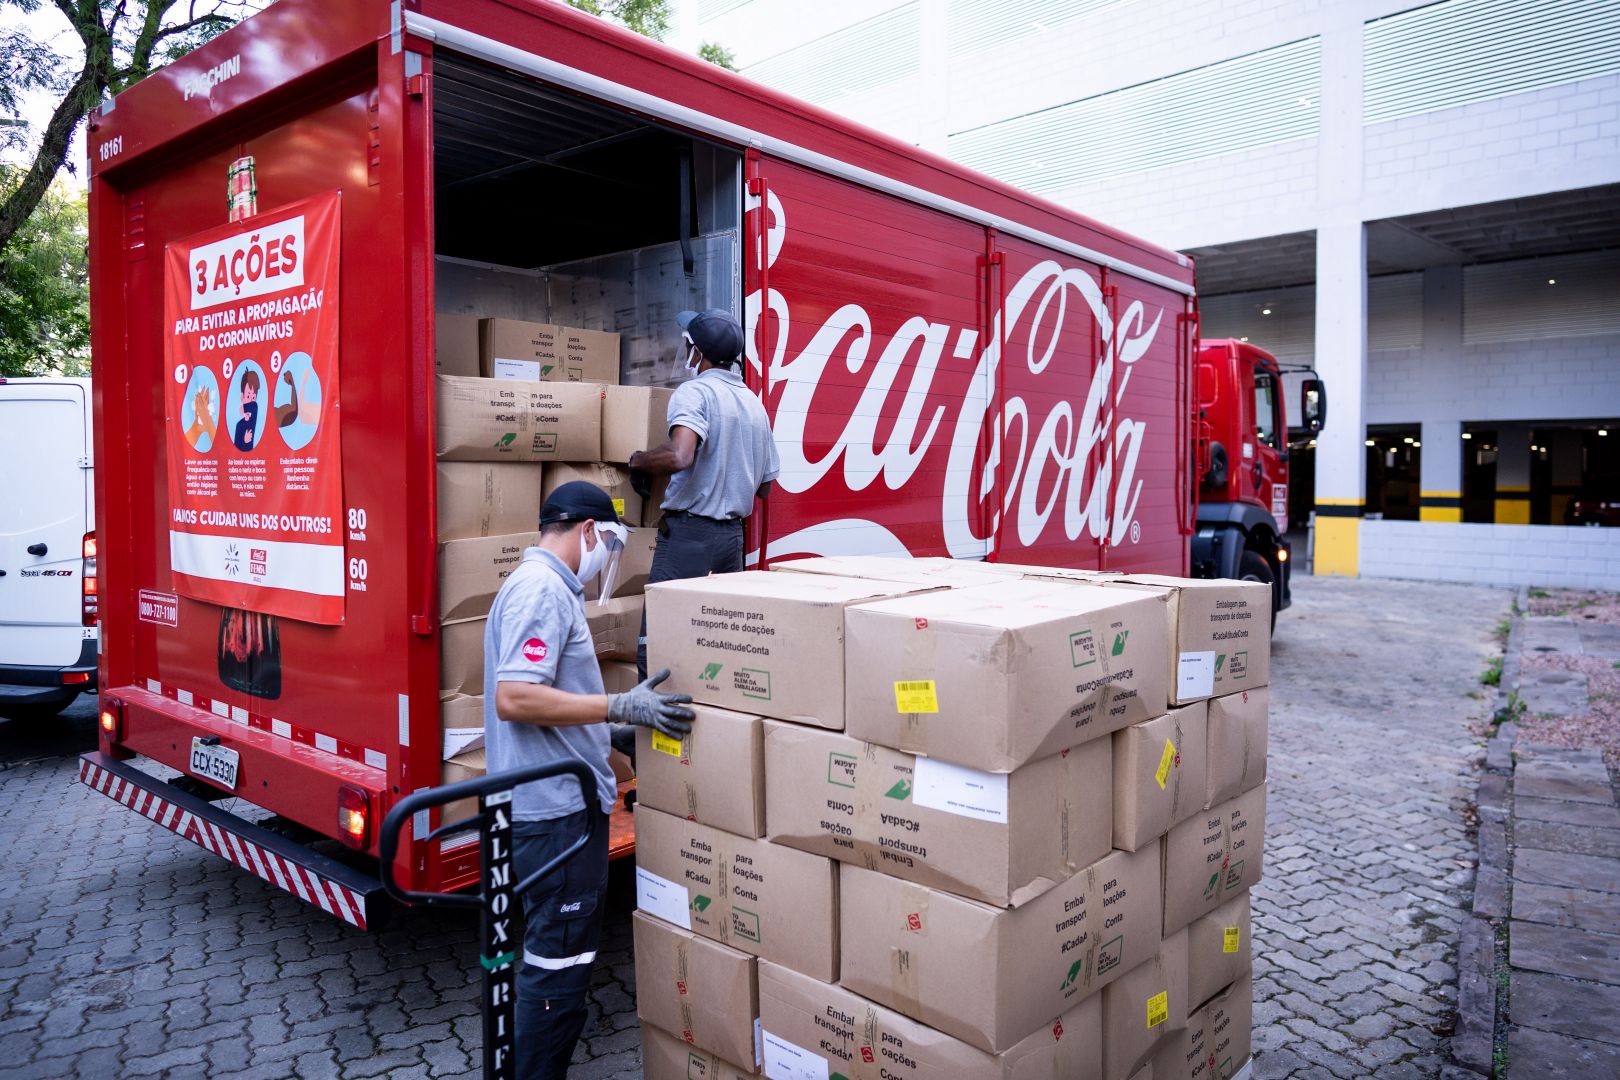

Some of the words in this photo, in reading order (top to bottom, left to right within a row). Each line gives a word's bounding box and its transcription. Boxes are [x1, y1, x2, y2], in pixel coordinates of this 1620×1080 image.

[99, 135, 123, 161] 18161
[195, 259, 206, 295] 3
[213, 233, 297, 295] AÇÕES
[202, 309, 236, 331] EVITAR
[238, 307, 246, 324] A
[199, 335, 215, 351] DO
[217, 319, 293, 348] CORONAVÍRUS
[200, 510, 237, 528] CUIDAR
[239, 513, 259, 529] UNS
[261, 514, 278, 531] DOS
[280, 516, 331, 534] OUTROS!
[348, 508, 366, 530] 80
[349, 558, 367, 580] 60
[701, 605, 744, 619] Embalagem
[746, 612, 764, 621] para
[691, 618, 728, 630] transporte
[730, 622, 740, 631] de
[741, 623, 775, 636] doações
[696, 637, 770, 656] #CadaAtitudeConta
[193, 750, 235, 783] CCX-5330
[827, 800, 854, 815] Conta
[820, 820, 852, 836] oações
[880, 813, 920, 833] #CadaA
[690, 838, 712, 852] Emba
[735, 854, 753, 865] para
[833, 837, 854, 849] para
[680, 849, 712, 865] transpor
[733, 885, 758, 901] Conta
[1103, 879, 1117, 893] para
[1105, 913, 1123, 929] Conta
[490, 809, 510, 1080] ALMOXARIF
[826, 1005, 855, 1026] Embal
[881, 1031, 903, 1048] para
[814, 1014, 855, 1041] transport
[881, 1047, 917, 1069] oações
